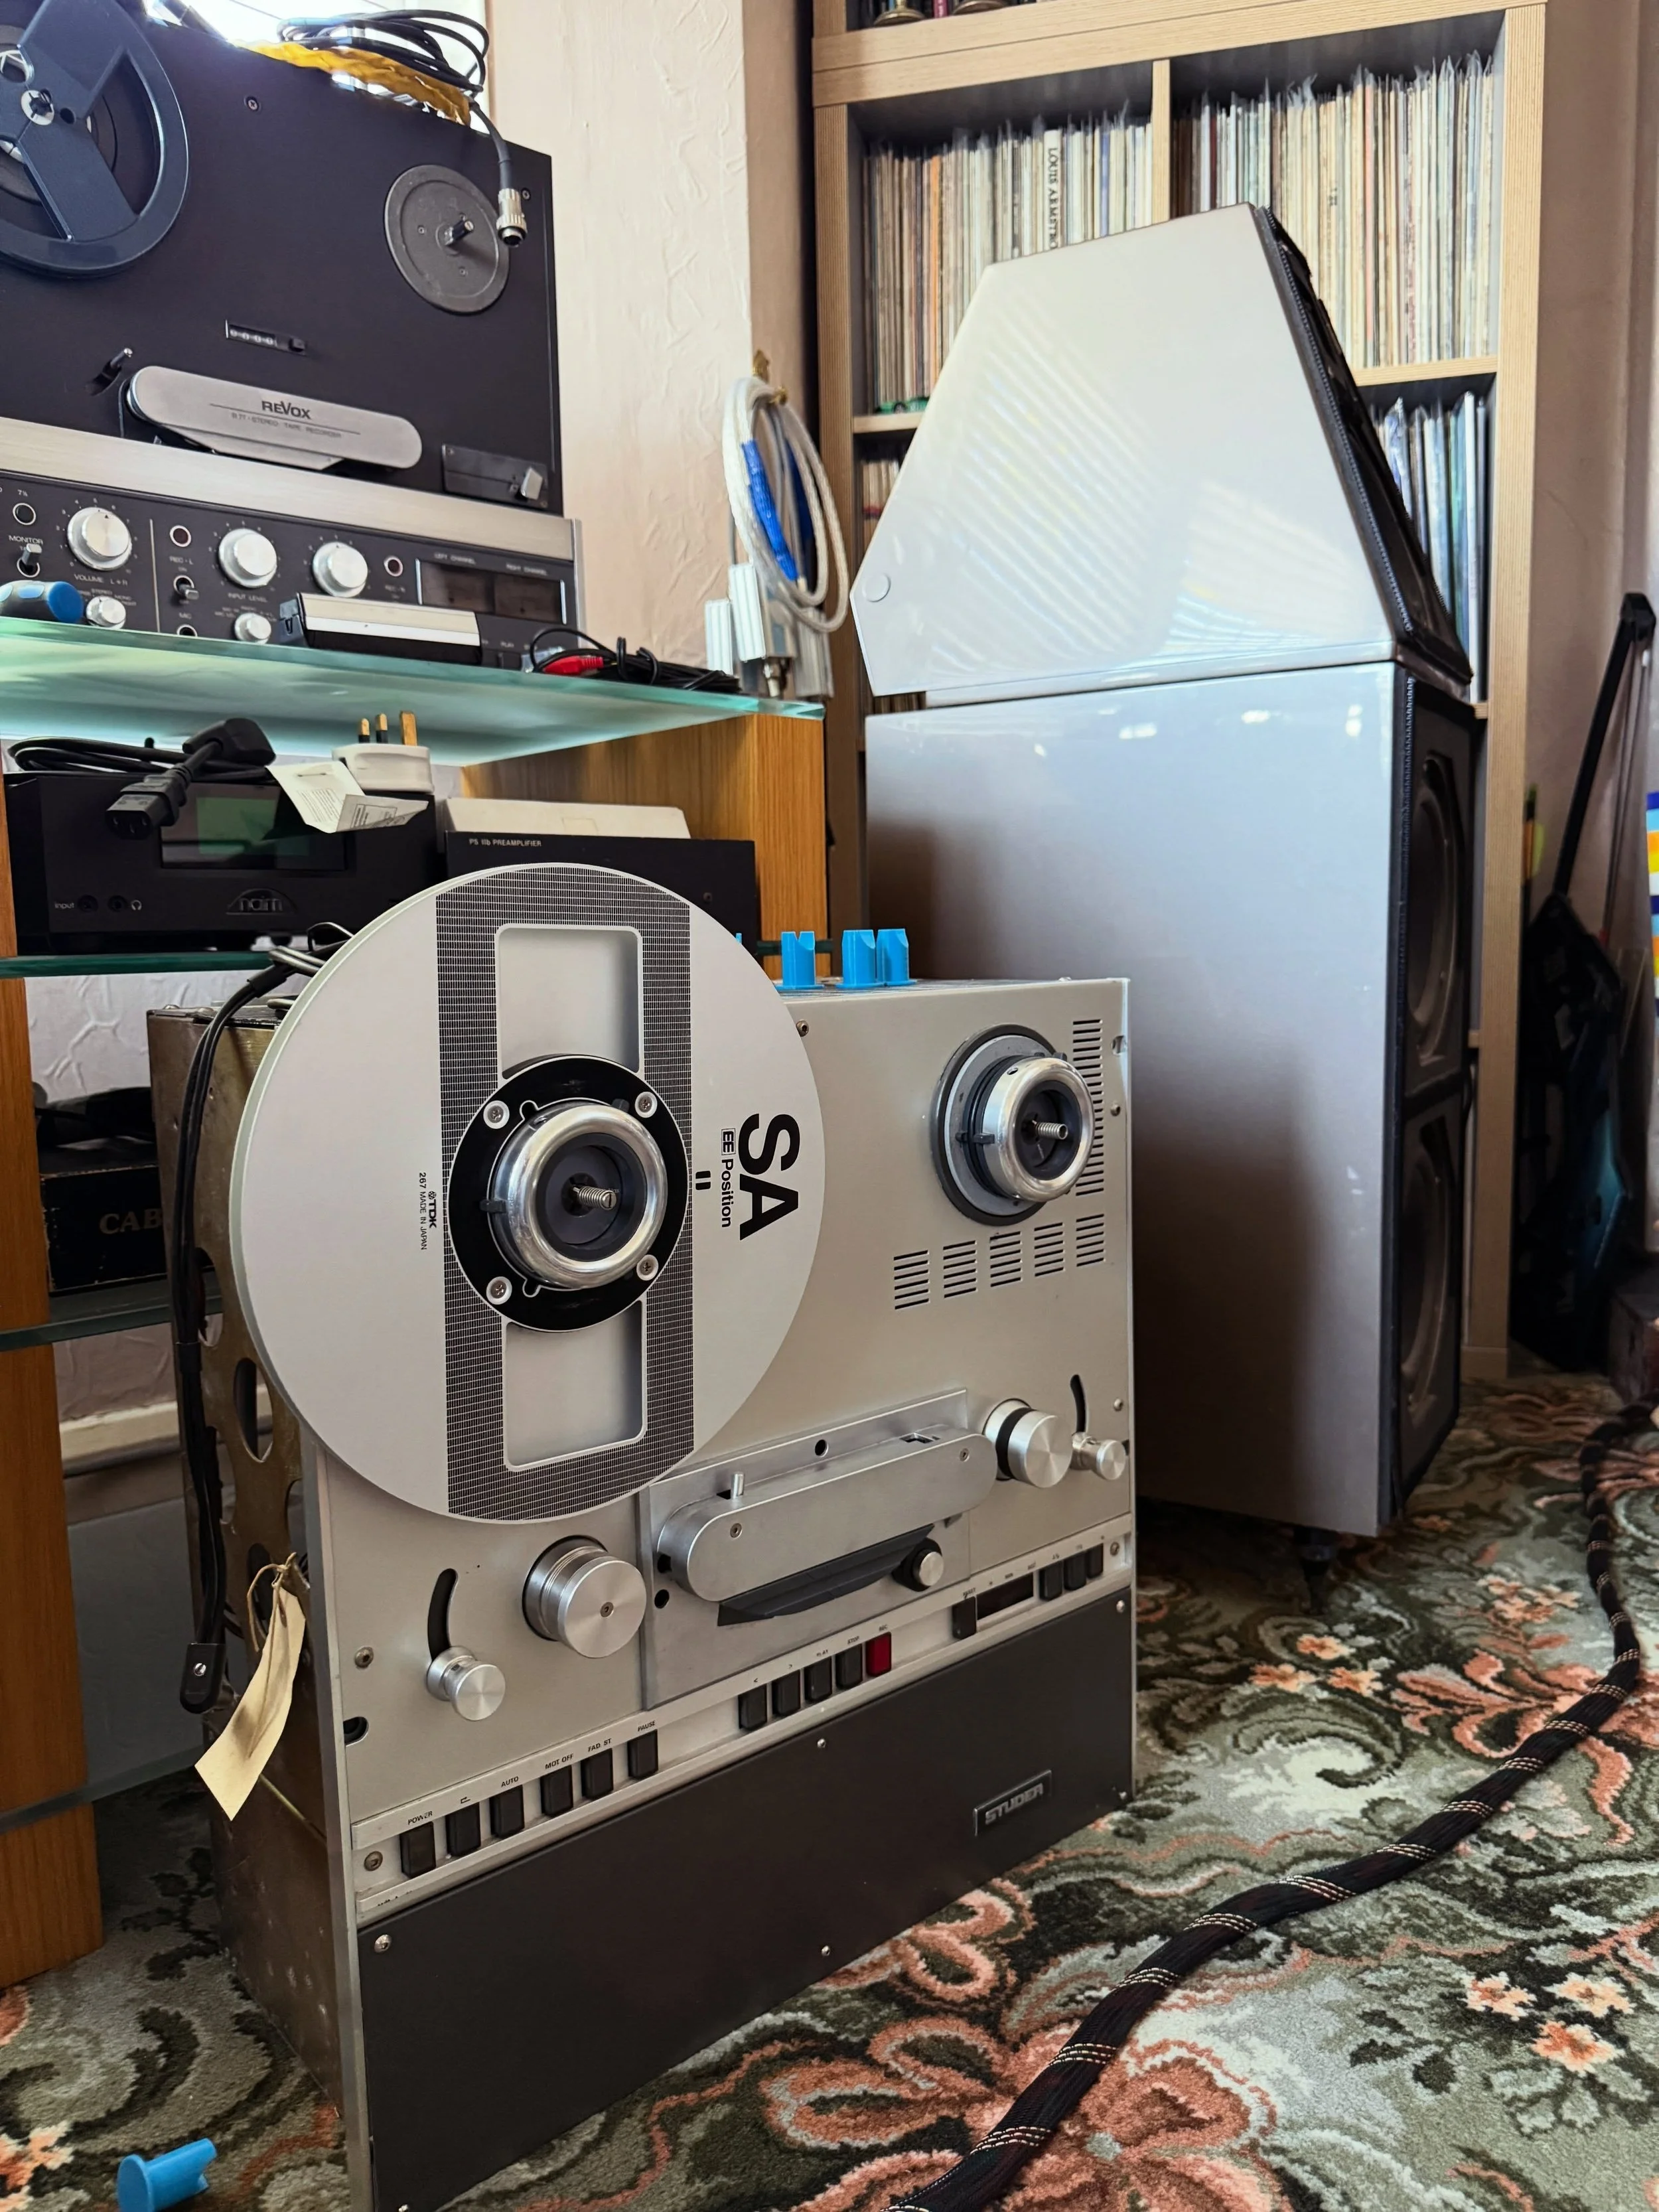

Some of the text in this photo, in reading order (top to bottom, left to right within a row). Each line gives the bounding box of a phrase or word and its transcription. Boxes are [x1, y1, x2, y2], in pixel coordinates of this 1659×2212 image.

[1048, 147, 1058, 184] LOUIS
[9, 535, 43, 546] MONITOR
[74, 573, 104, 583] VOLUME
[492, 838, 541, 847] PREAMPLIFIER
[738, 1113, 800, 1241] SA
[721, 1158, 734, 1228] Position
[99, 1208, 163, 1234] CAB
[637, 1720, 656, 1732] PAUSE
[603, 1737, 613, 1747] ST
[545, 1753, 575, 1770] MOT OFF
[500, 1775, 520, 1788] AUTO
[407, 1810, 433, 1826] POWER
